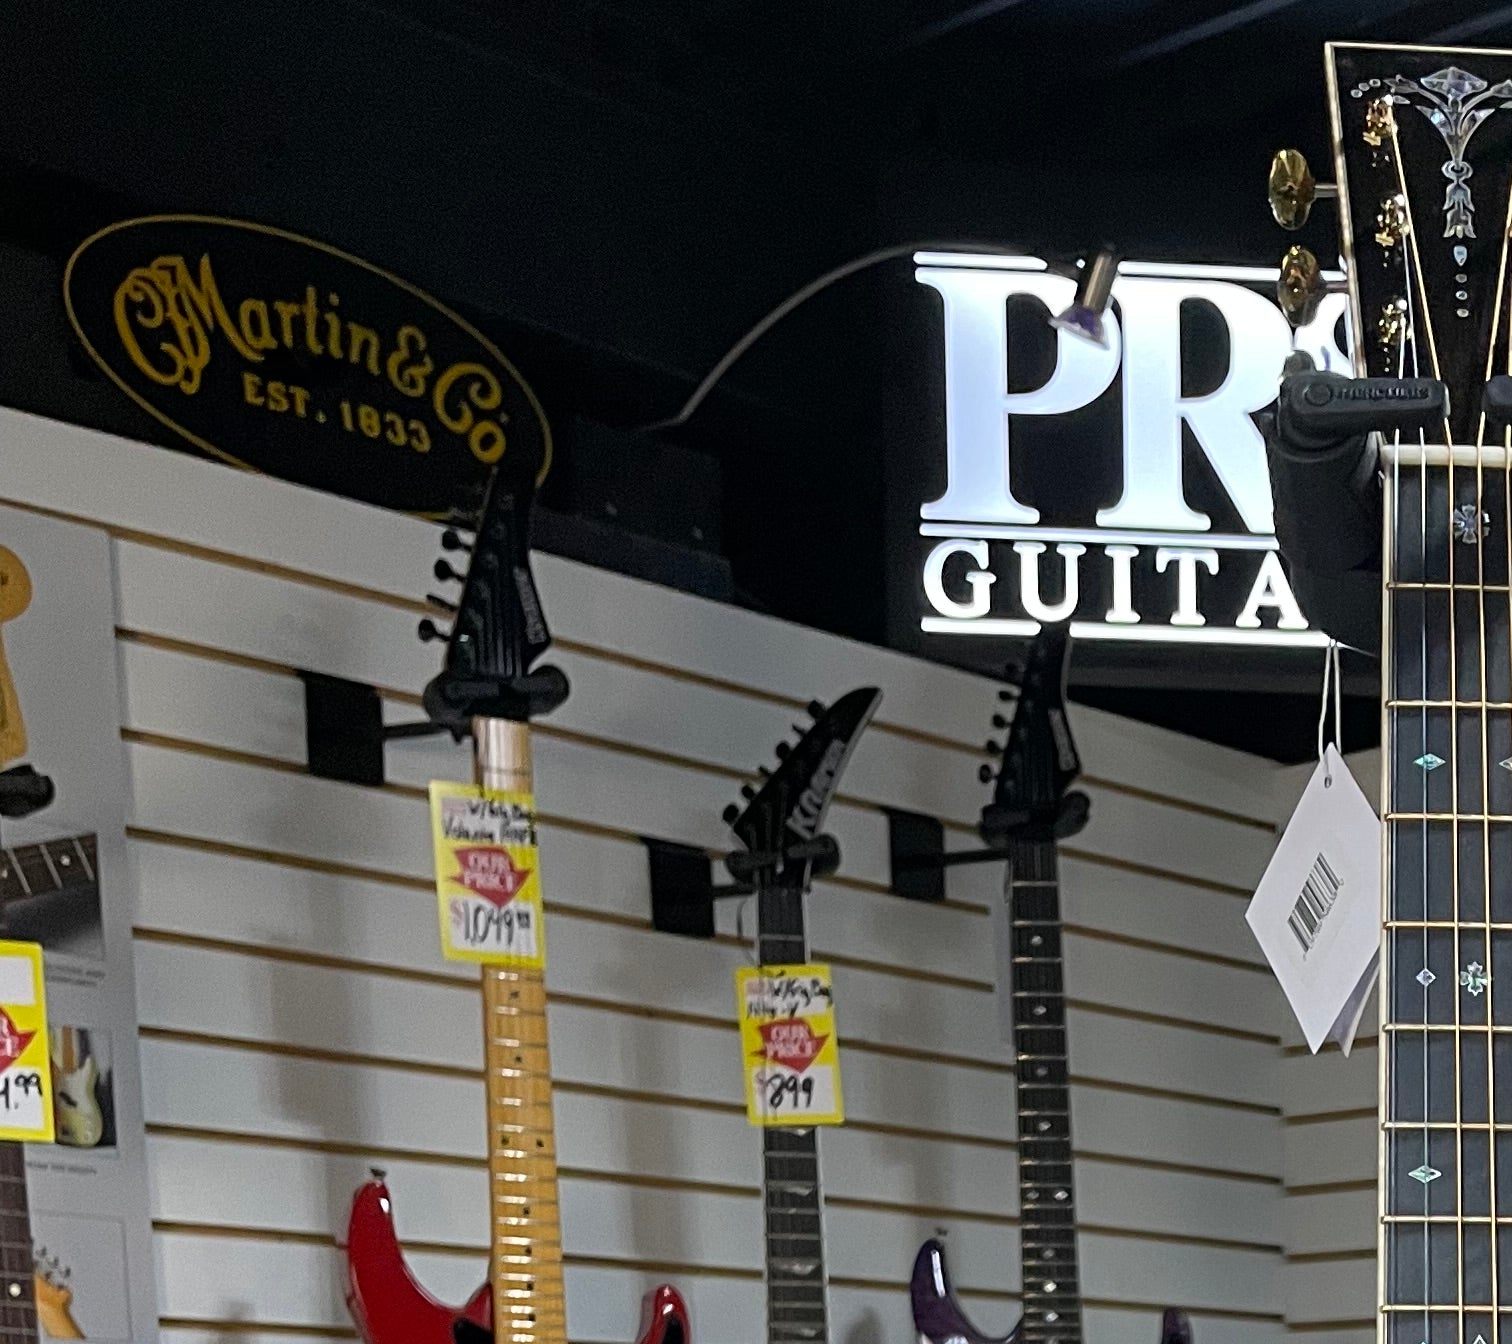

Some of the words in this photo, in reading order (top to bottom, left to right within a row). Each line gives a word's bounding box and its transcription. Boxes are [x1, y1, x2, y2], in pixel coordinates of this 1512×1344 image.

[242, 372, 328, 424] EST.
[340, 401, 431, 453] 1833
[922, 539, 1310, 632] GUITA
